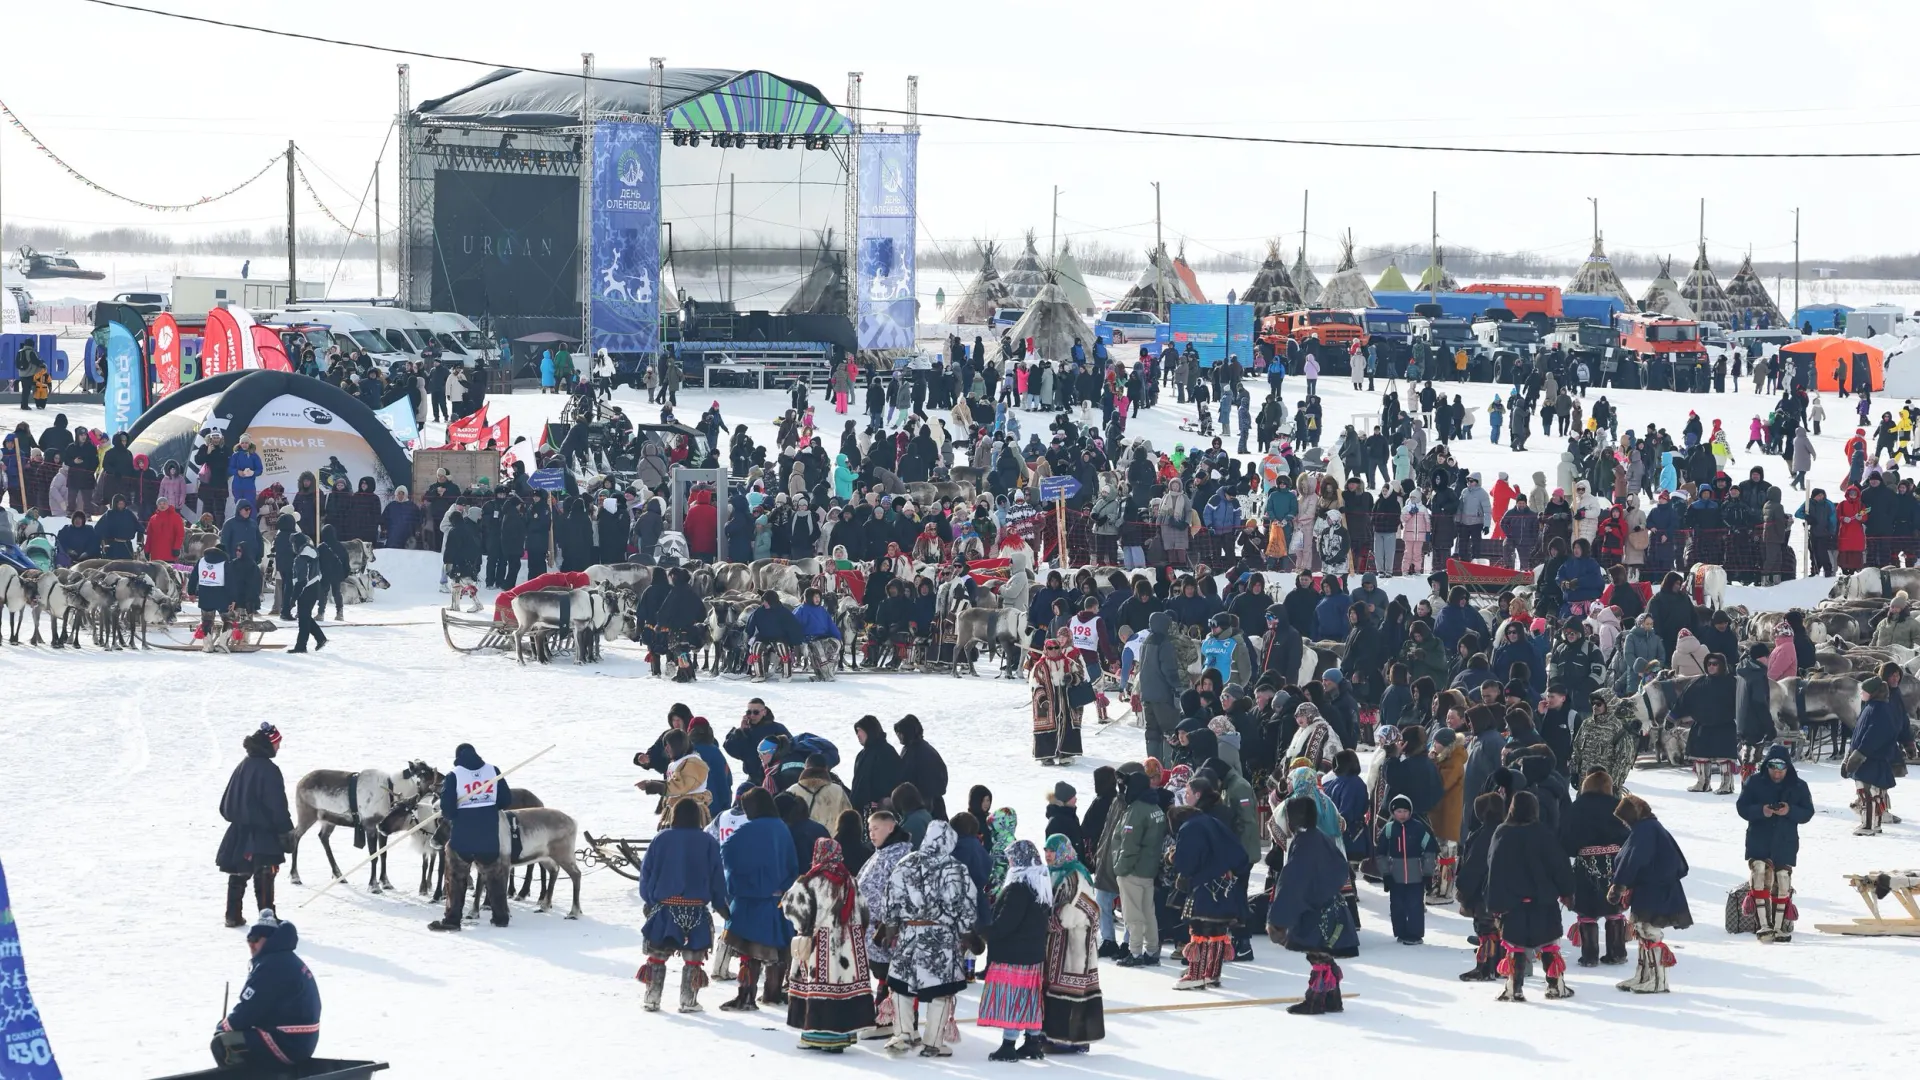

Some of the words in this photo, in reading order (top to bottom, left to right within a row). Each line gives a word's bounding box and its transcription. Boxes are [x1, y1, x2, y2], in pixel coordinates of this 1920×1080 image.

[620, 189, 641, 199] ДЕНЬ
[884, 195, 901, 204] ДЕНЬ
[606, 199, 651, 211] ОЛЕНЕВОДА
[872, 205, 908, 215] ОЛЕНЕВОДА
[463, 235, 552, 256] URAAN
[261, 437, 304, 448] XTRIM
[307, 438, 326, 448] RE
[202, 570, 216, 580] 94
[1073, 626, 1091, 637] 198
[464, 780, 494, 794] 102
[8, 1038, 50, 1066] 430
